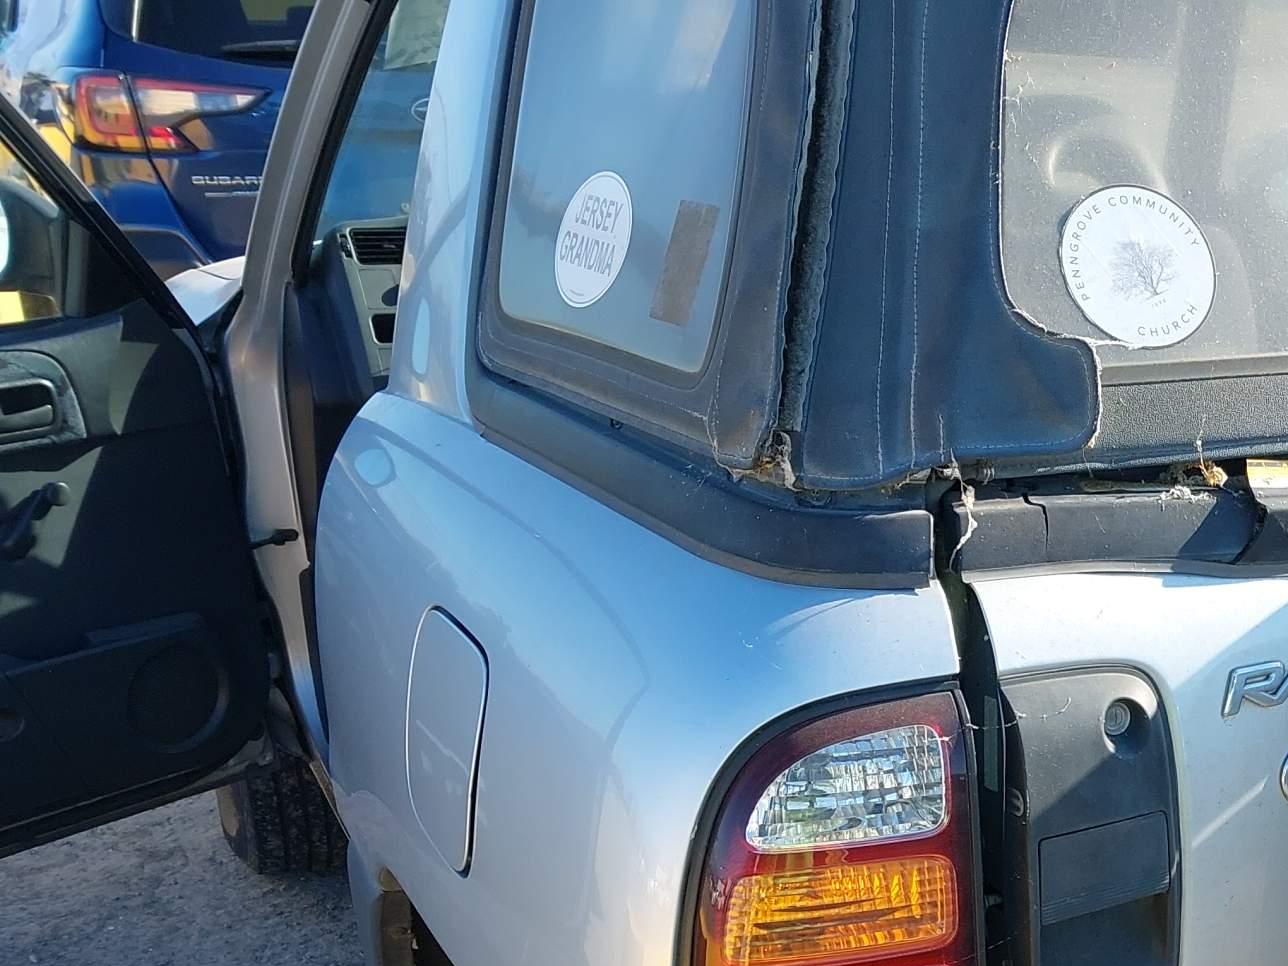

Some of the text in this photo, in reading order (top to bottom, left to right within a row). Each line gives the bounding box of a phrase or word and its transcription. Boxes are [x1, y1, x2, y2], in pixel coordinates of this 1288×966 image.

[575, 194, 624, 234] JERSEY
[560, 230, 616, 277] GRANDMA
[1069, 195, 1199, 301] PENNGROVE COMMUNITY
[1137, 304, 1198, 337] CHURCH
